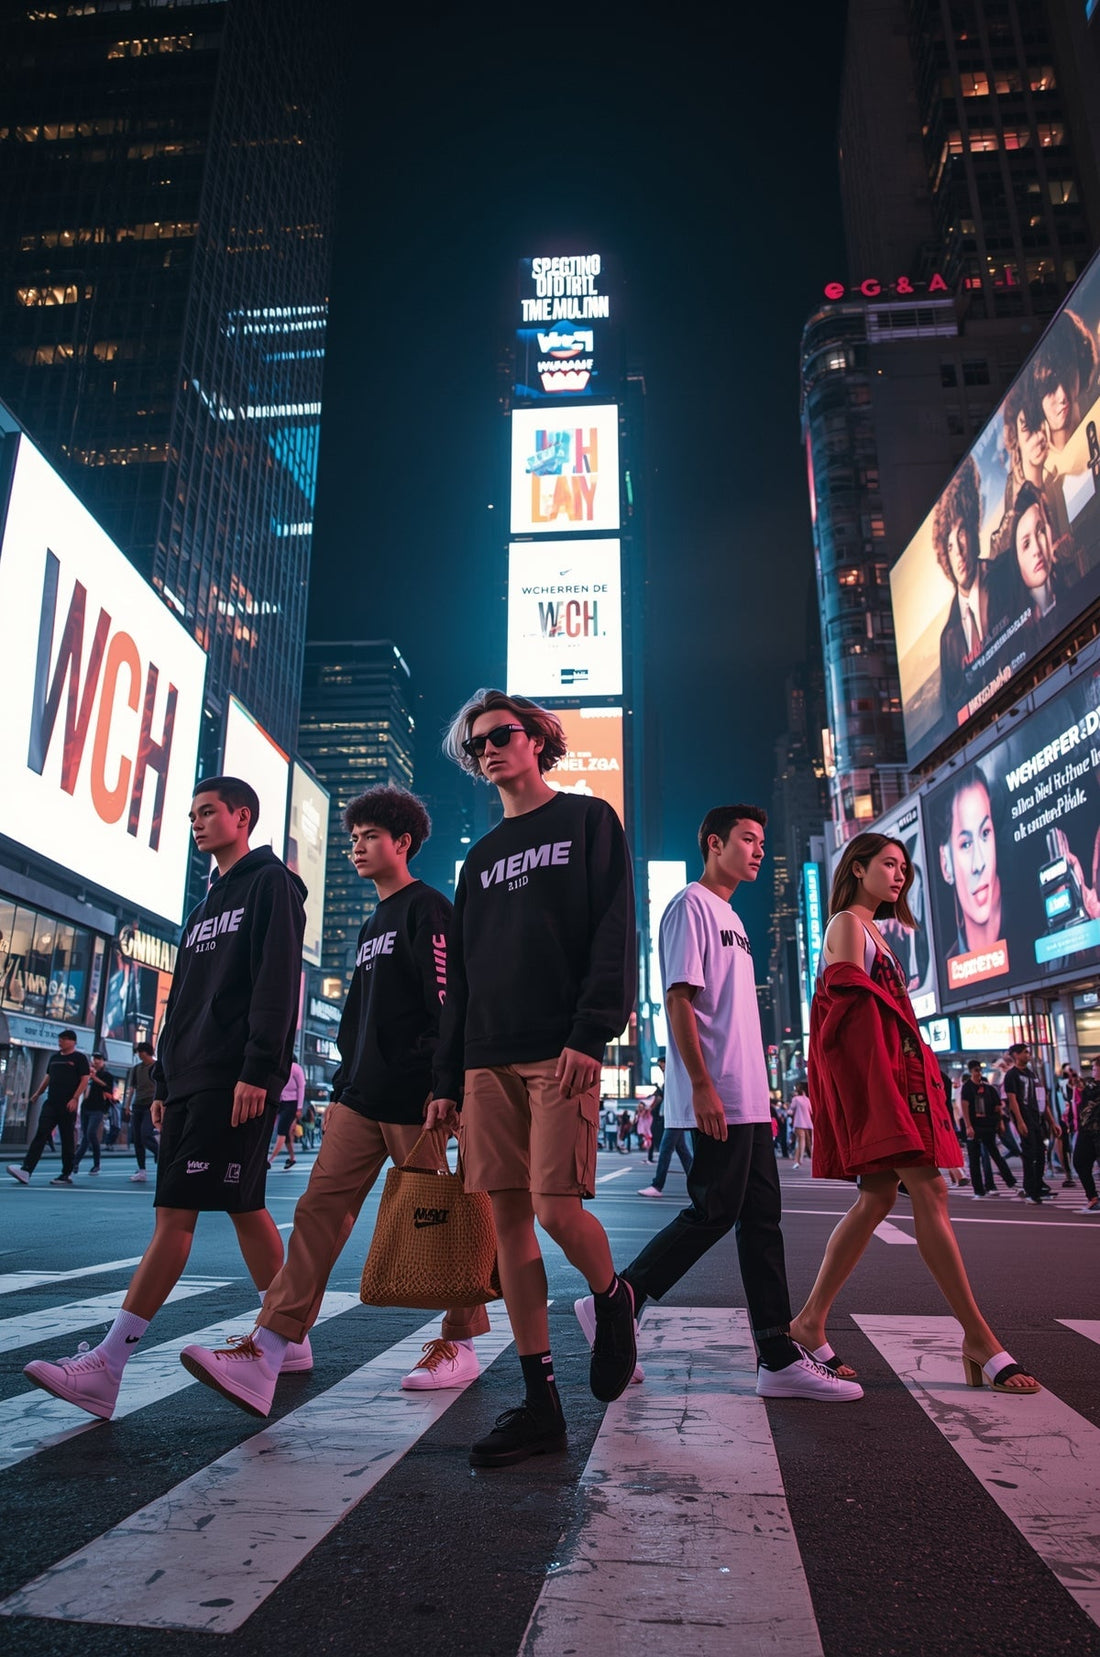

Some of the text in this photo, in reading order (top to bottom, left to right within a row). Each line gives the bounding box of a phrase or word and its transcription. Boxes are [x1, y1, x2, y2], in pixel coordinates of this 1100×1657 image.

[521, 584, 608, 595] WCHERREN DE
[27, 547, 179, 853] WCH
